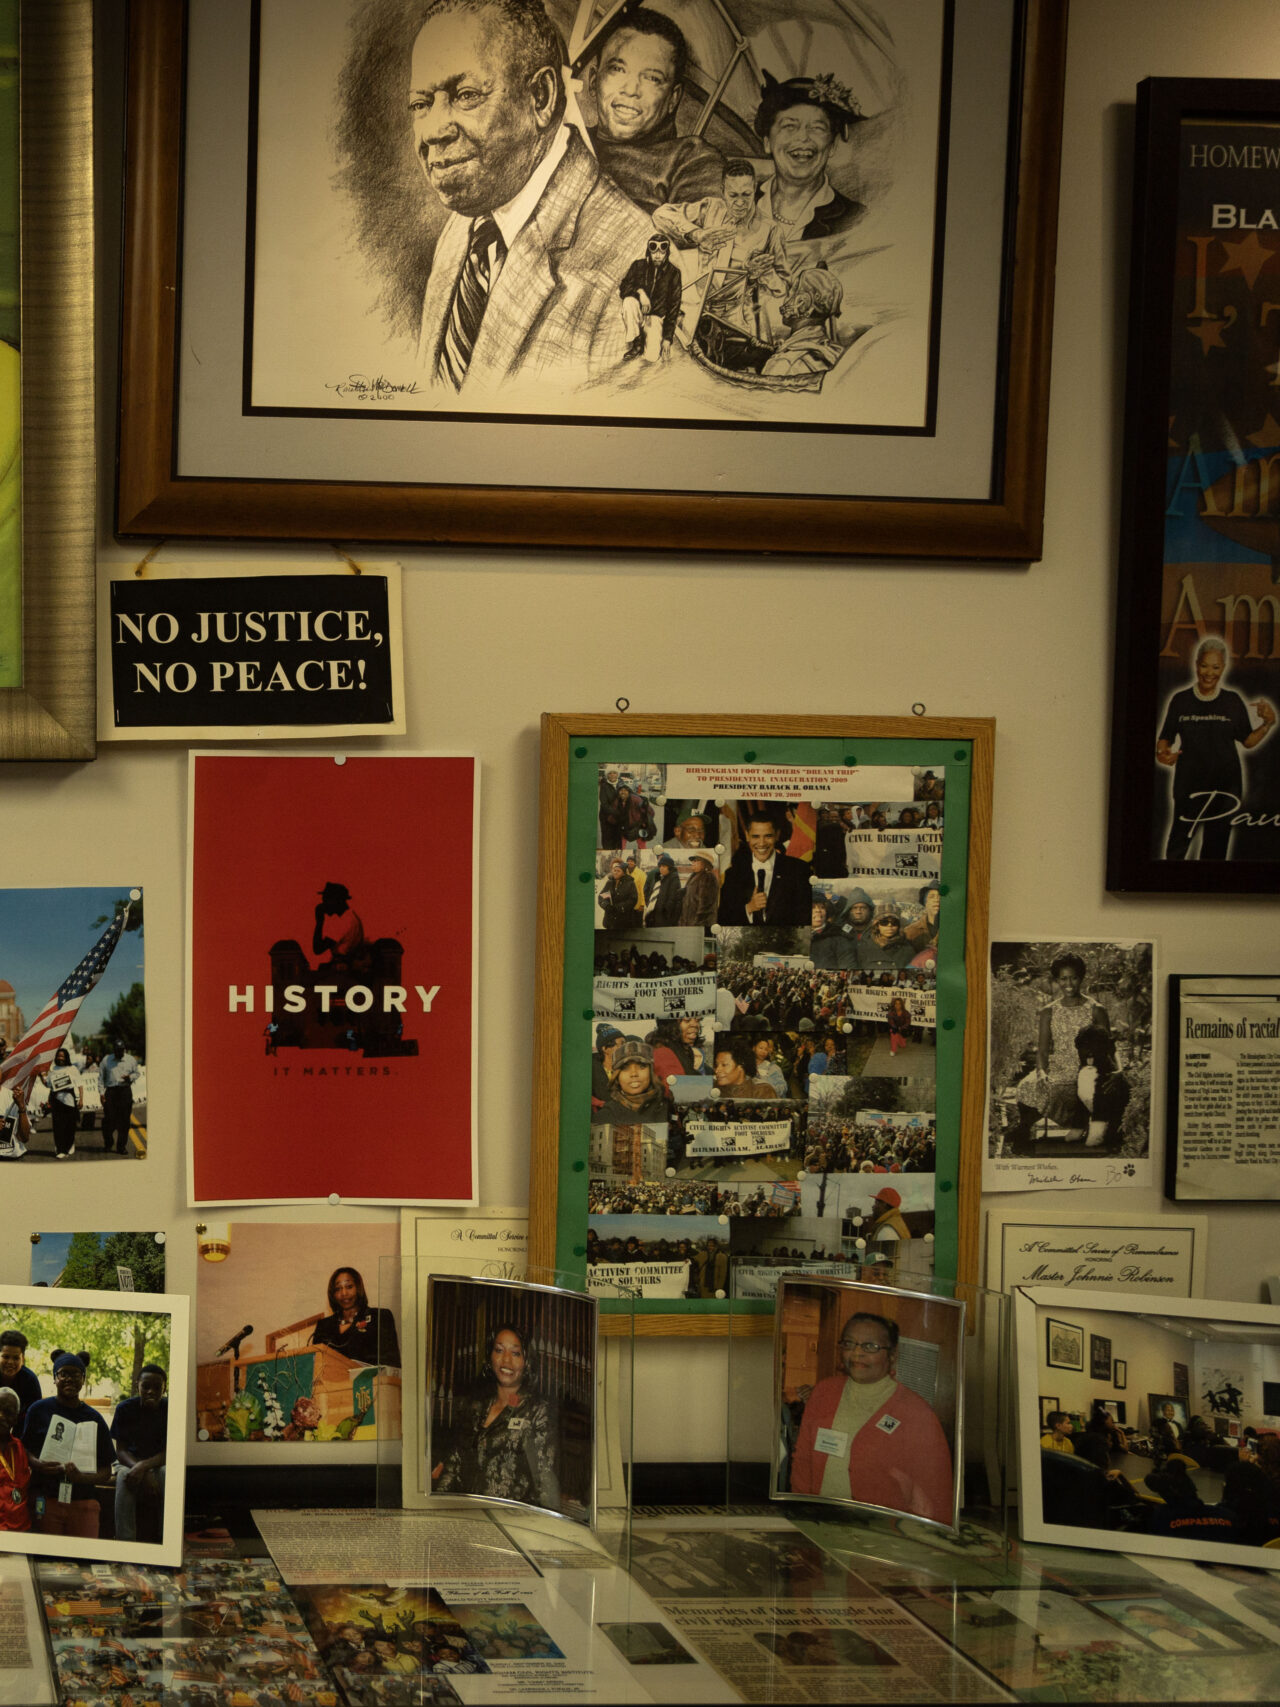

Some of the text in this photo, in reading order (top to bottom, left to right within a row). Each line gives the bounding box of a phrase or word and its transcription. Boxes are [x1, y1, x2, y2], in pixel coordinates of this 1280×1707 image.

[115, 610, 383, 648] NO JUSTICE,
[132, 659, 368, 694] NO PEACE!
[877, 834, 910, 843] RIGHTS
[852, 867, 939, 879] BIRMINGHAM
[228, 984, 441, 1014] HISTORY
[1185, 1016, 1234, 1039] Remains
[1236, 1016, 1247, 1039] of
[273, 1067, 291, 1076] IT
[1022, 1264, 1174, 1286] Master Johnnie Robinson
[1169, 1517, 1233, 1529] COMPASSION
